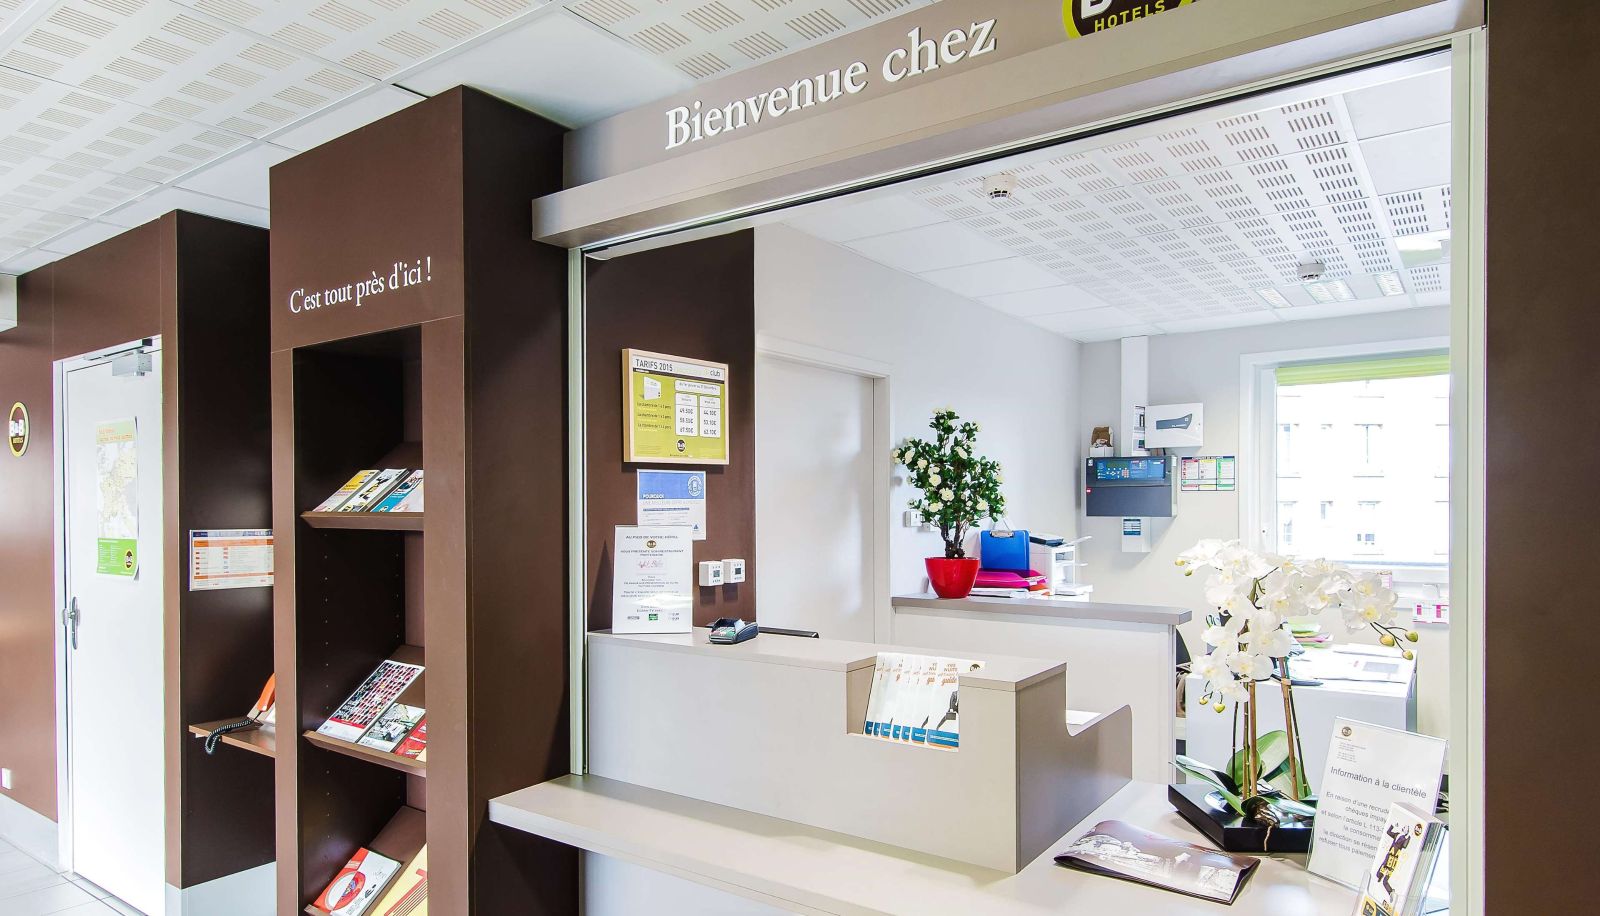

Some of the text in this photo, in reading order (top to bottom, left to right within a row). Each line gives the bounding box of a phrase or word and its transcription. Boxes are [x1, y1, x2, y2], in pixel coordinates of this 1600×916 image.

[1094, 0, 1165, 32] HOTELS
[665, 18, 997, 150] Bienvenue chez
[290, 288, 321, 313] C'est
[324, 283, 352, 306] tout
[356, 271, 385, 306] près
[389, 260, 422, 290] d'ici
[636, 359, 658, 370] TARIFS
[710, 369, 721, 377] club
[1330, 766, 1373, 785] Information
[1382, 780, 1390, 788] la
[1391, 784, 1427, 799] clientèle
[1370, 813, 1387, 825] impay
[1350, 826, 1381, 842] consomma
[1352, 847, 1376, 860] paiemen
